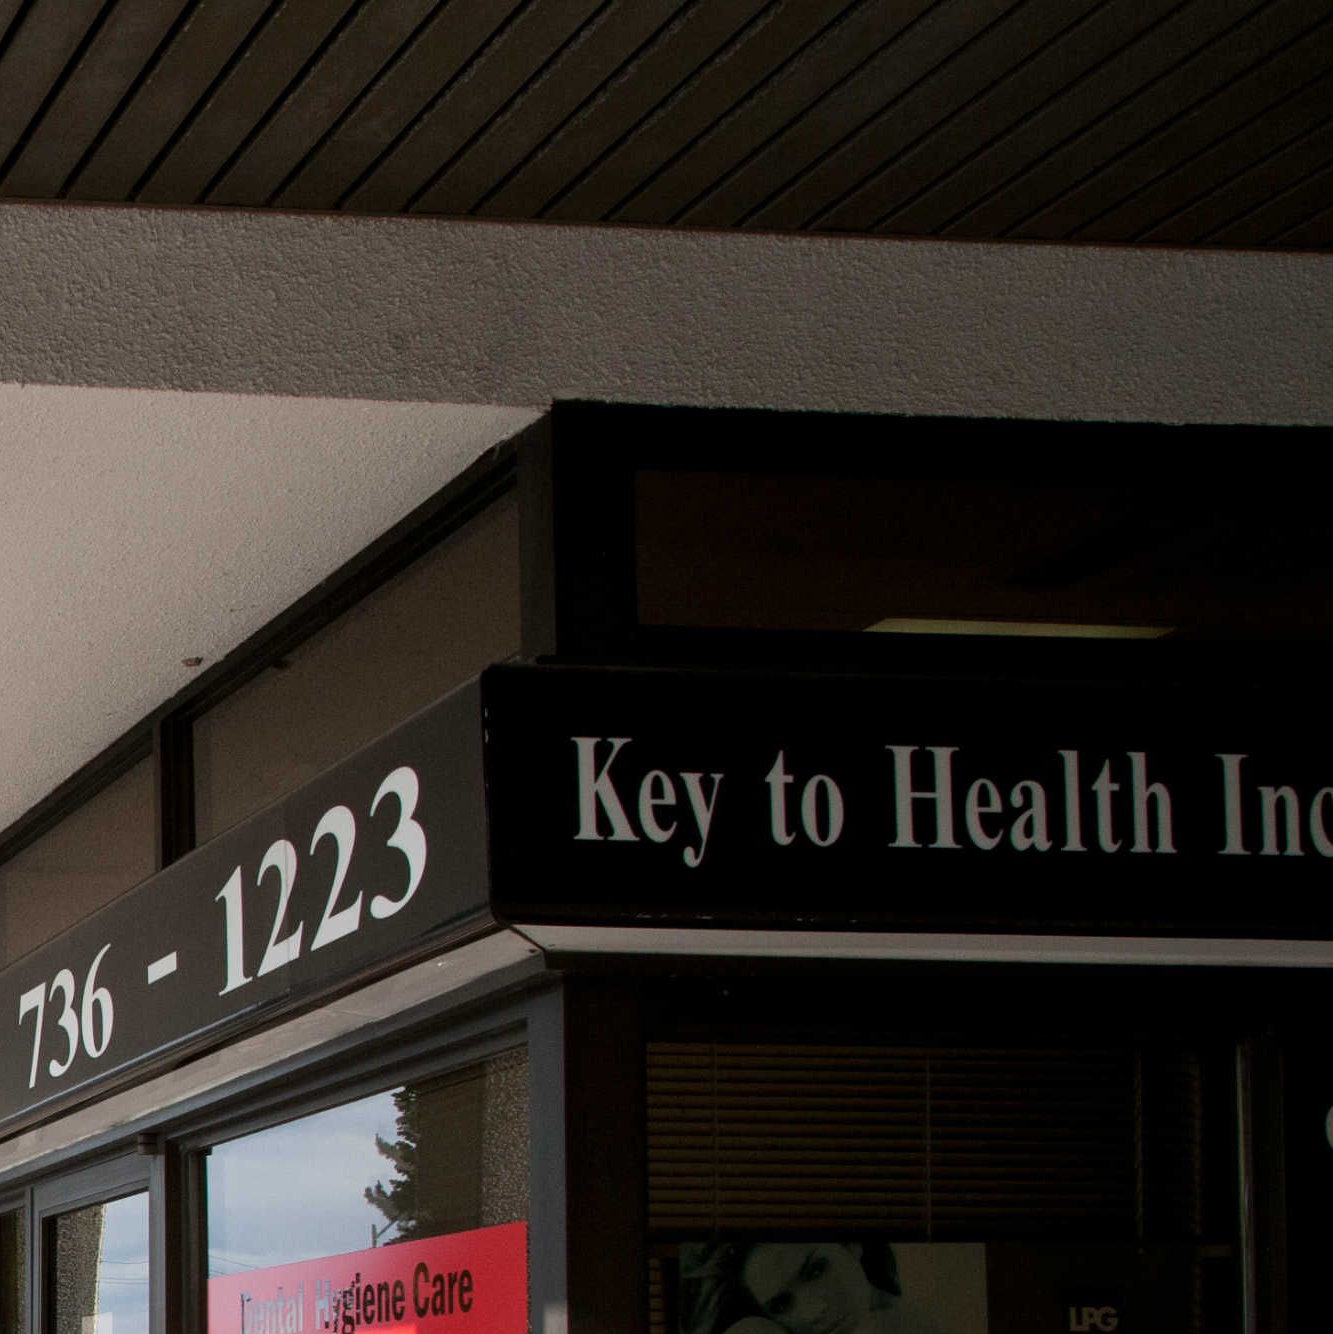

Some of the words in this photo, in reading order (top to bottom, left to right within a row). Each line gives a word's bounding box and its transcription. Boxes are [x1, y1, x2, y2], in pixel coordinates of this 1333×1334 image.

[570, 736, 724, 868] Key
[764, 749, 845, 847] to
[885, 745, 1178, 854] Health
[17, 943, 115, 1090] 736
[147, 951, 179, 986] -
[214, 766, 428, 997] 1223
[413, 1261, 474, 1319] Care
[1068, 1306, 1119, 1333] LPG
